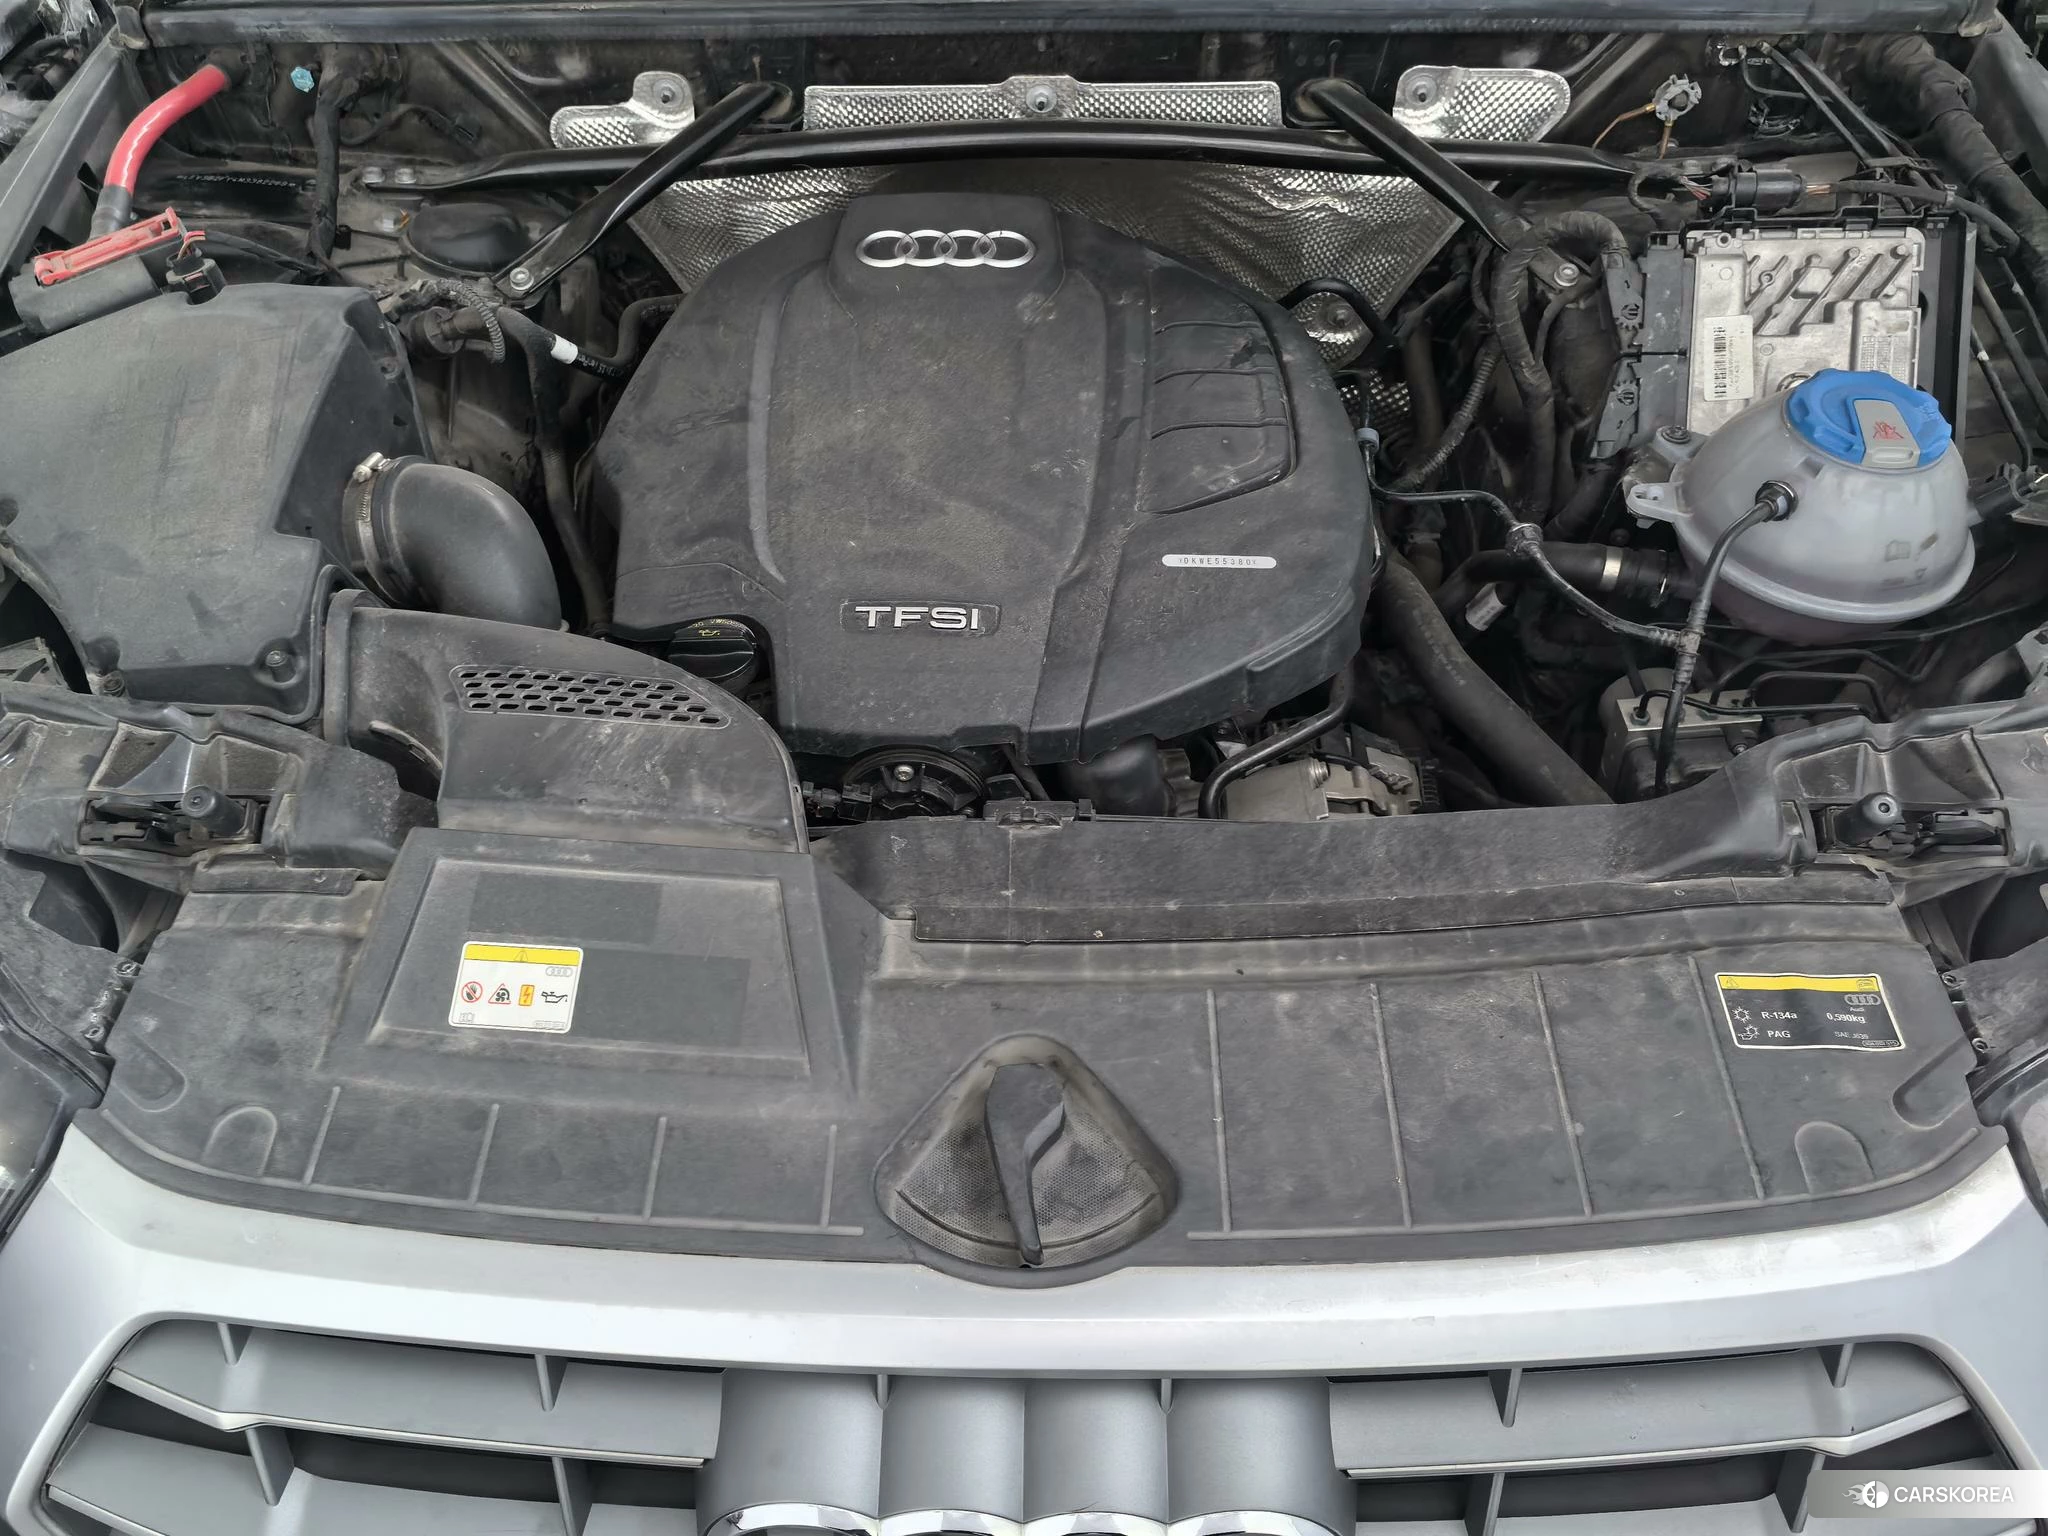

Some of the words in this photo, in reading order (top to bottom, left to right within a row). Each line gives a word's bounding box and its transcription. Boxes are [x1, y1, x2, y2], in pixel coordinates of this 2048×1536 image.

[855, 606, 979, 630] TFSI
[1761, 1011, 1798, 1020] R-134a
[1767, 1030, 1791, 1039] PAG
